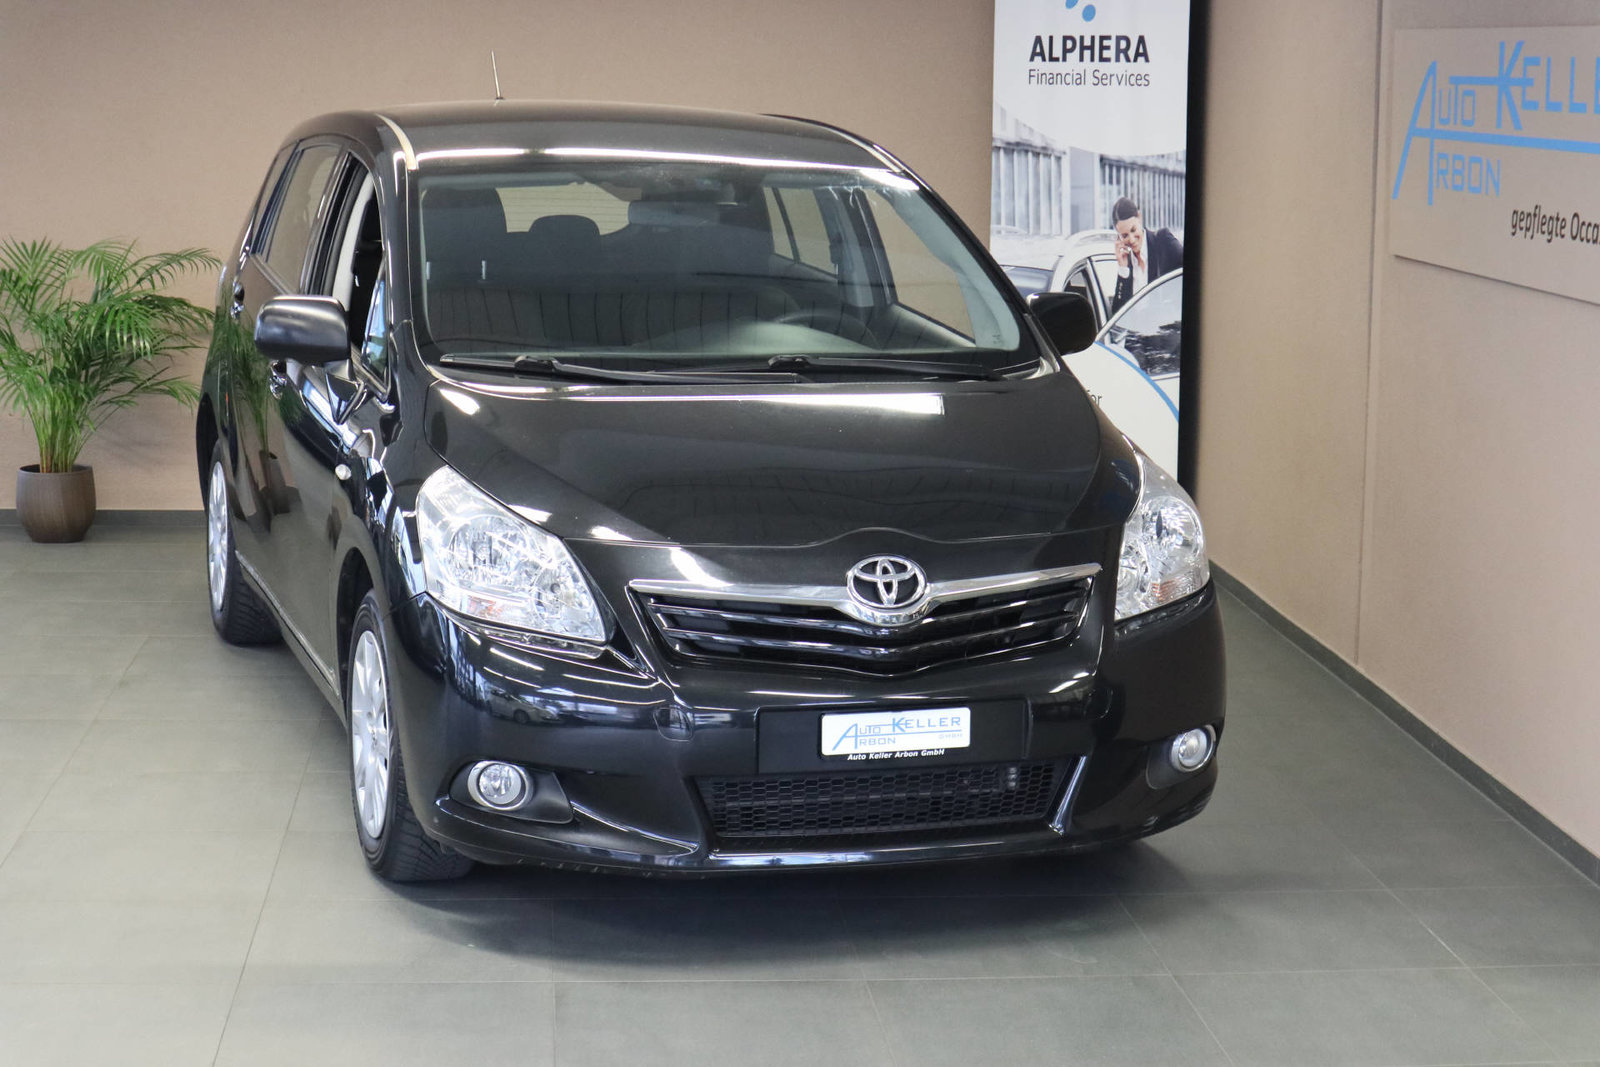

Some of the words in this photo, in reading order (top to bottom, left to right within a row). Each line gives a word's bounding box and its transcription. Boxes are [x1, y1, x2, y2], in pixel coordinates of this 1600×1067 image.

[1029, 35, 1150, 63] ALPHERA
[1028, 68, 1086, 86] Financial
[1092, 69, 1150, 87] Services
[1511, 204, 1567, 243] gepflegte
[892, 716, 961, 733] KELLER
[847, 753, 867, 761] Auto
[868, 752, 893, 760] Keller
[895, 750, 918, 758] Arbon
[921, 748, 945, 757] GmbH
